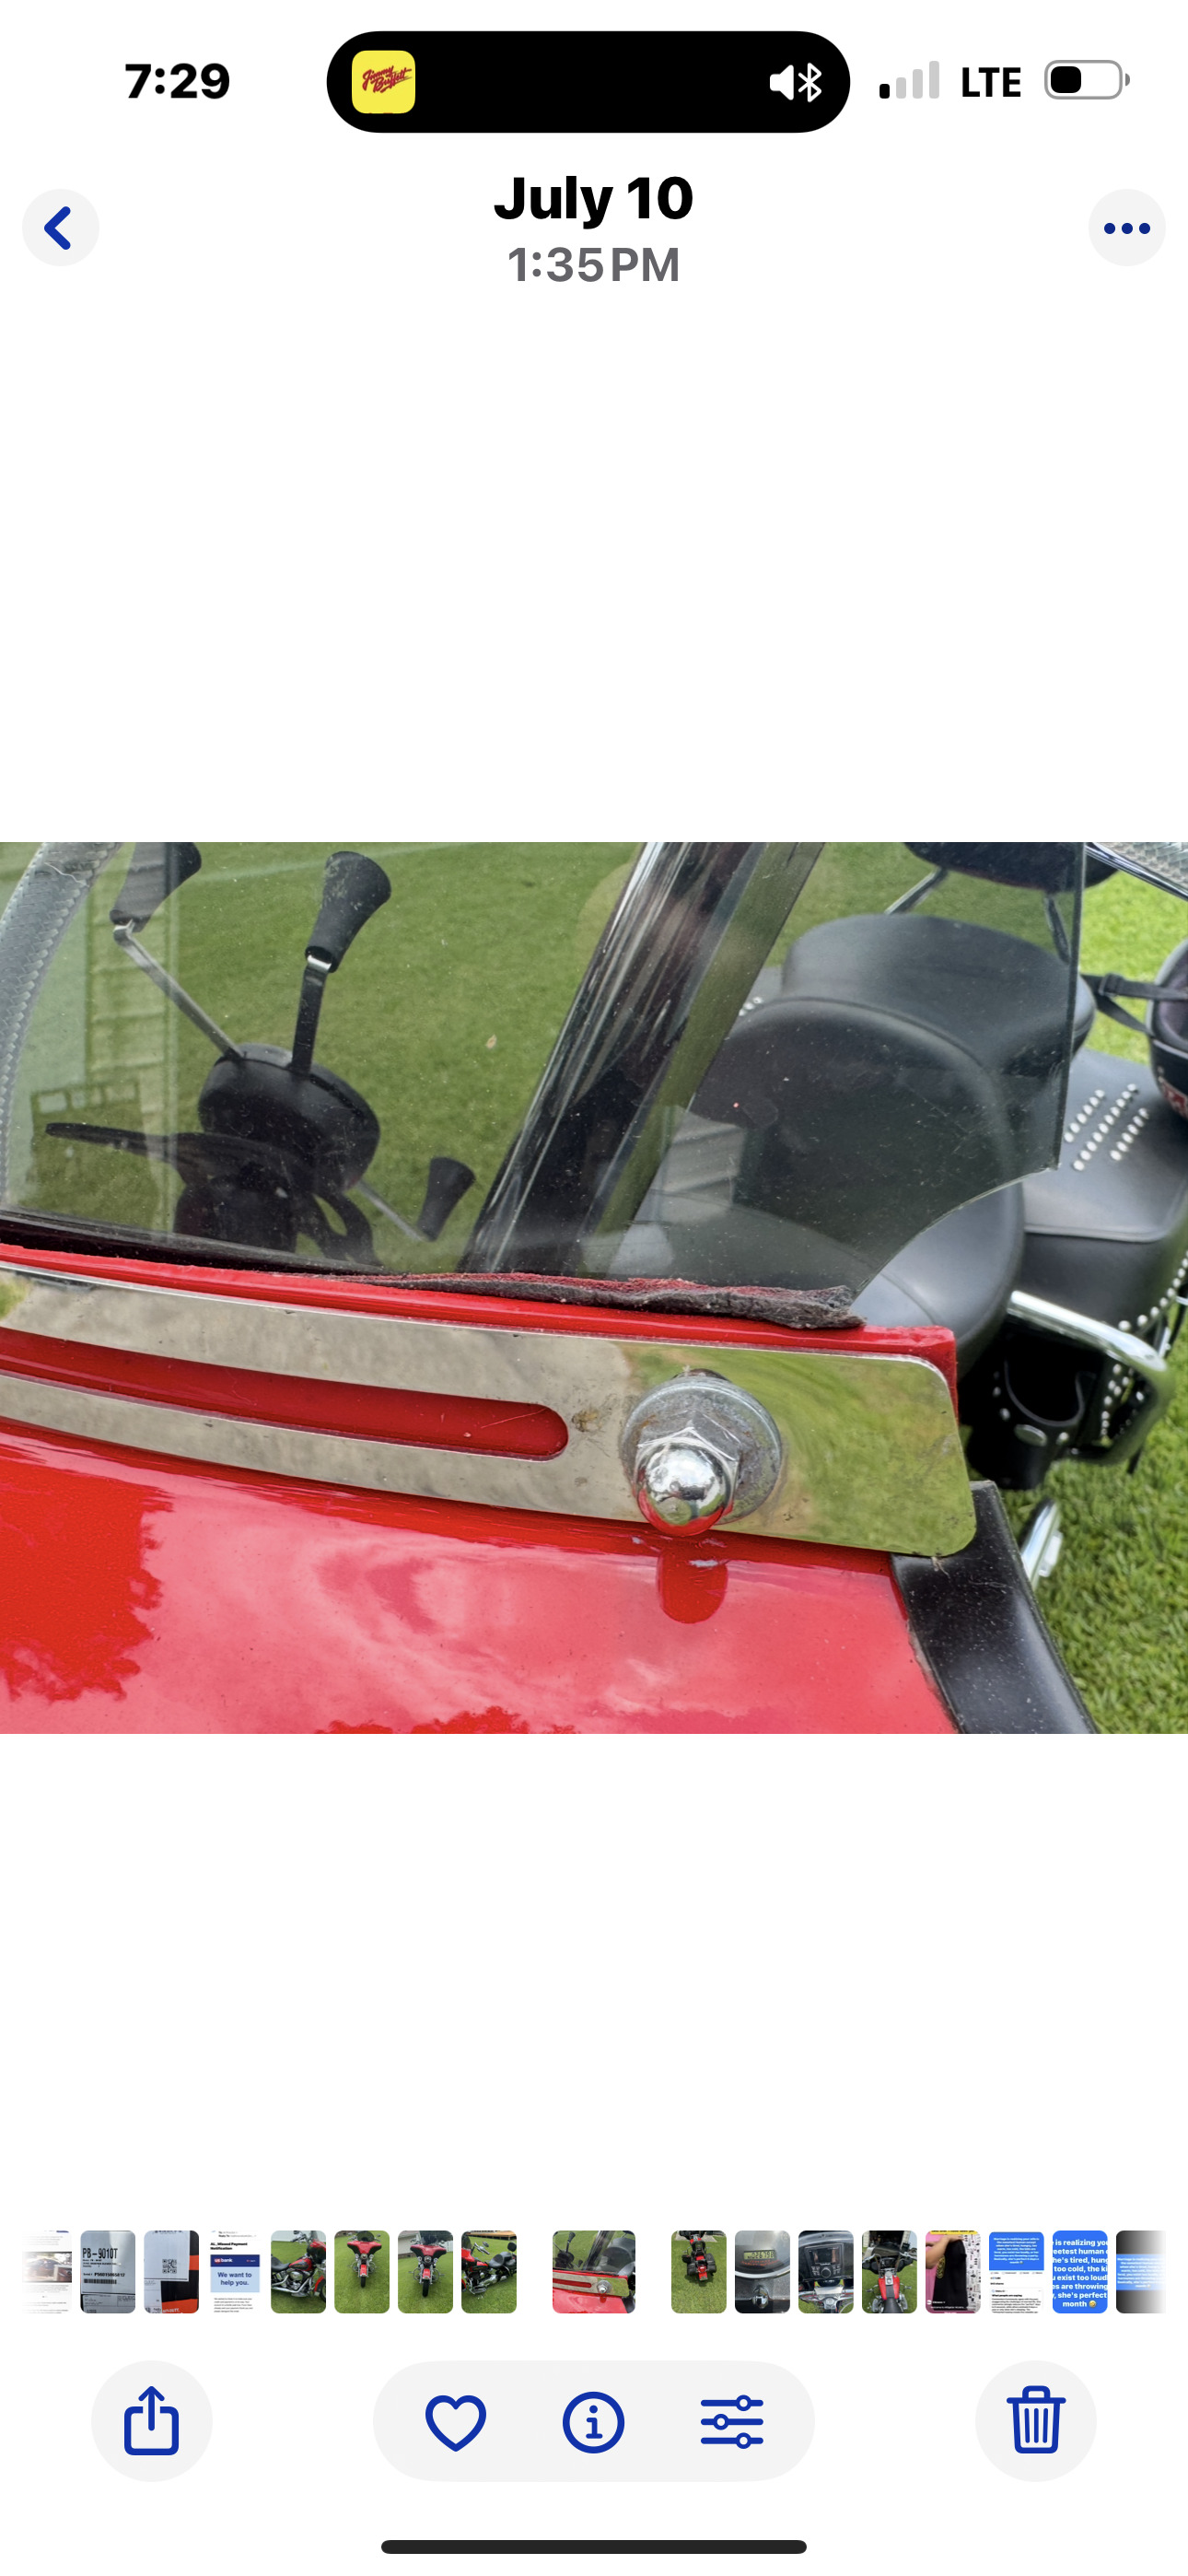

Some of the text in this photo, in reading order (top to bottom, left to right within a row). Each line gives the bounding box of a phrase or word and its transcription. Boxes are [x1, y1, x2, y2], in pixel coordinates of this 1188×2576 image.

[125, 64, 229, 99] 7:29
[362, 65, 394, 91] Jimmy
[370, 67, 413, 93] Buffett
[962, 67, 1020, 97] LTE
[495, 176, 693, 229] July 10
[1069, 2256, 1089, 2265] tired,
